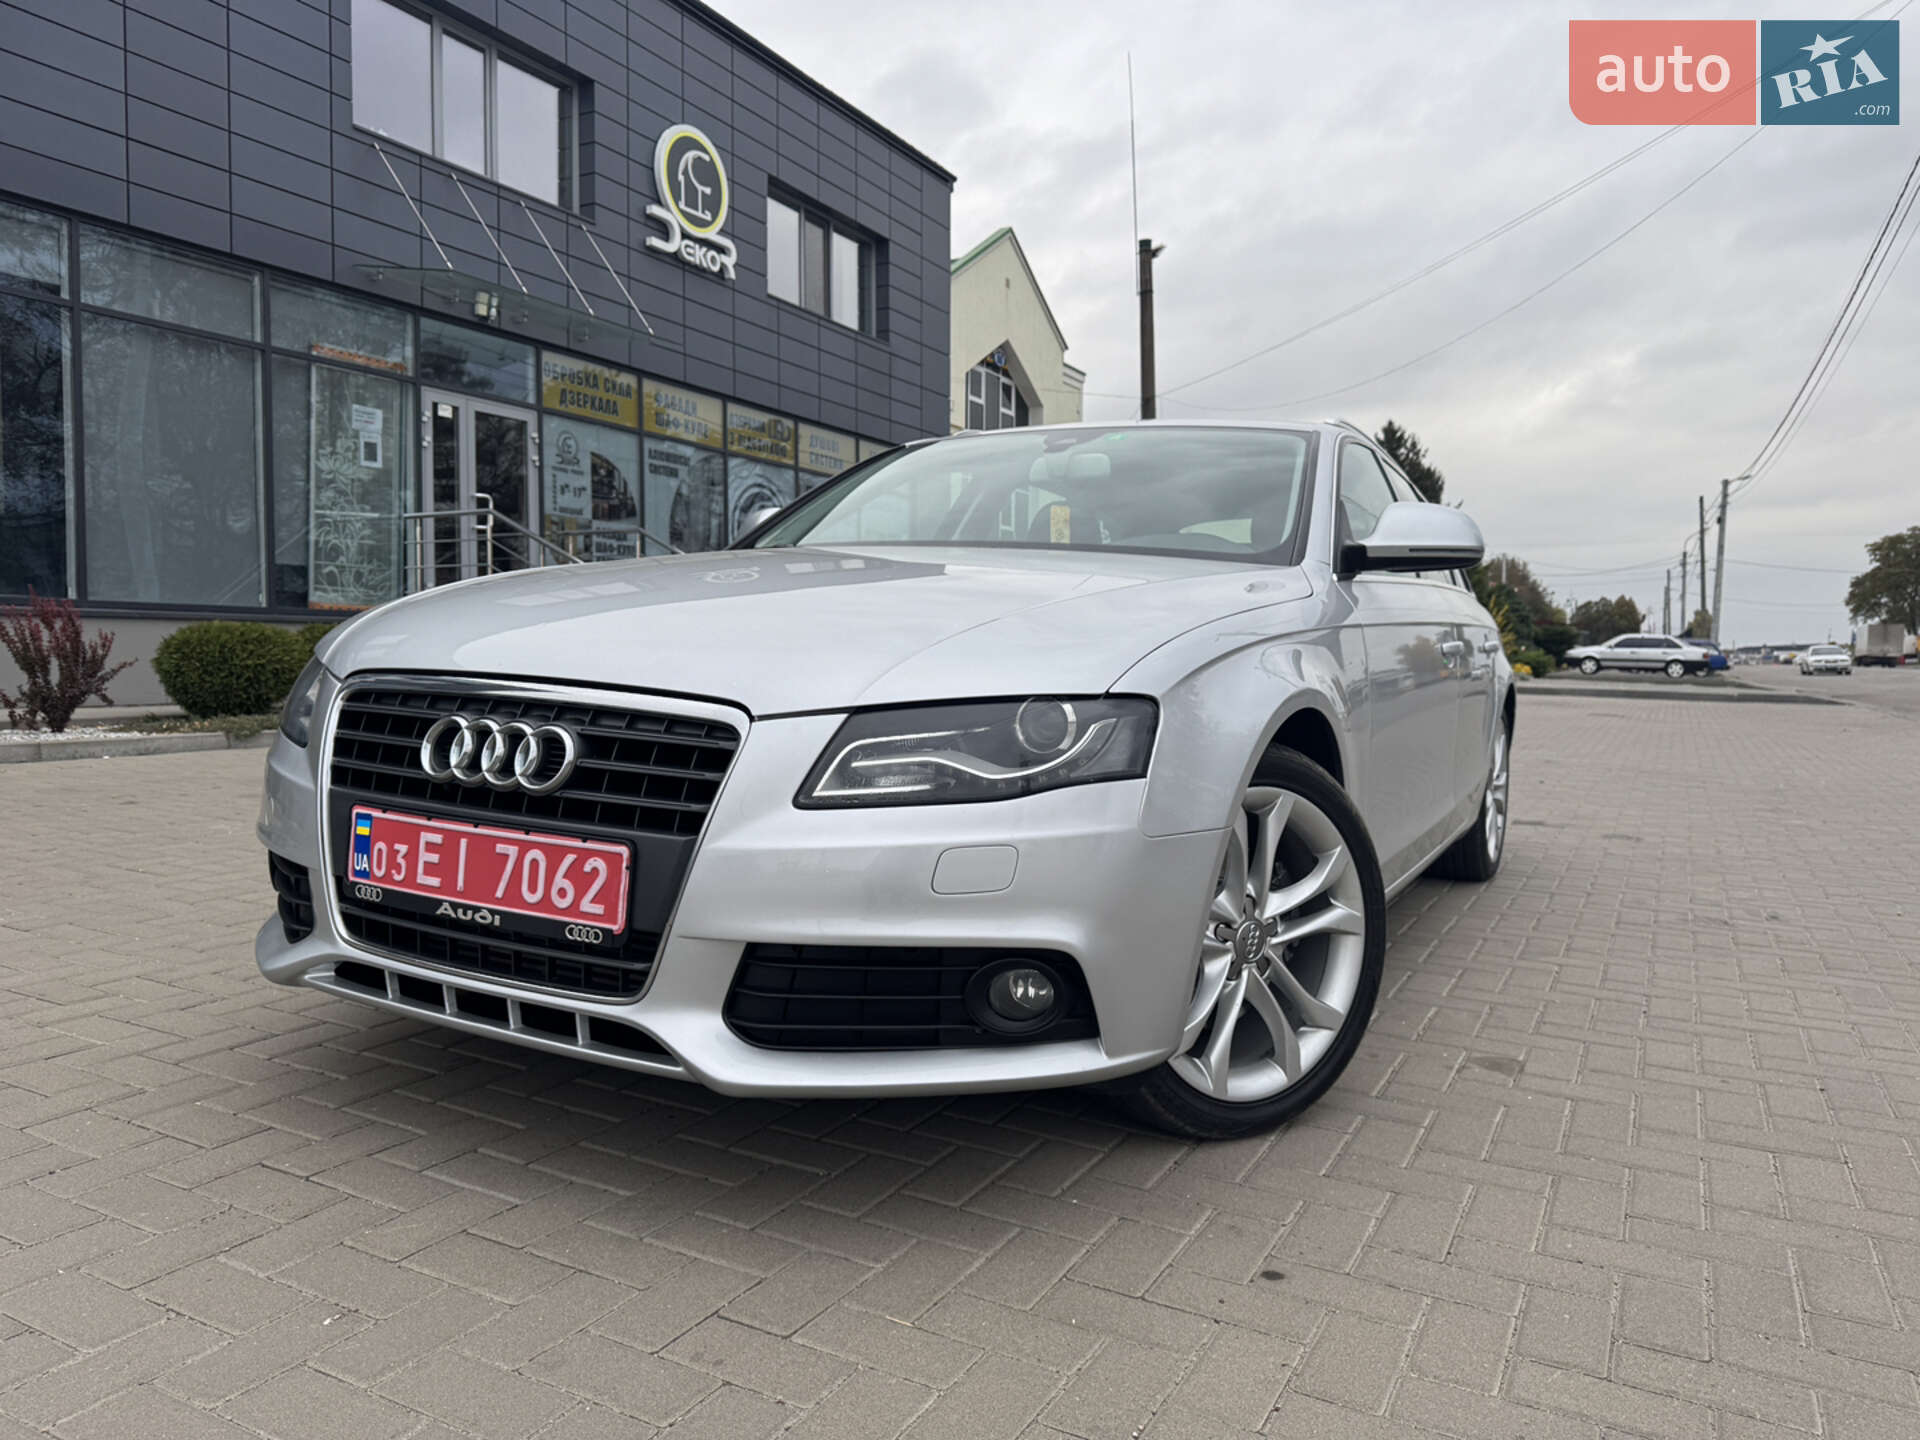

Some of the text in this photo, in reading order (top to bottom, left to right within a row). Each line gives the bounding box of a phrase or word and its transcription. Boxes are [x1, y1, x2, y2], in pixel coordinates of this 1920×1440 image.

[559, 387, 619, 417] ДЗЕРКАЛА
[354, 853, 369, 872] UA
[495, 843, 608, 916] 7062
[435, 902, 501, 926] Audi
